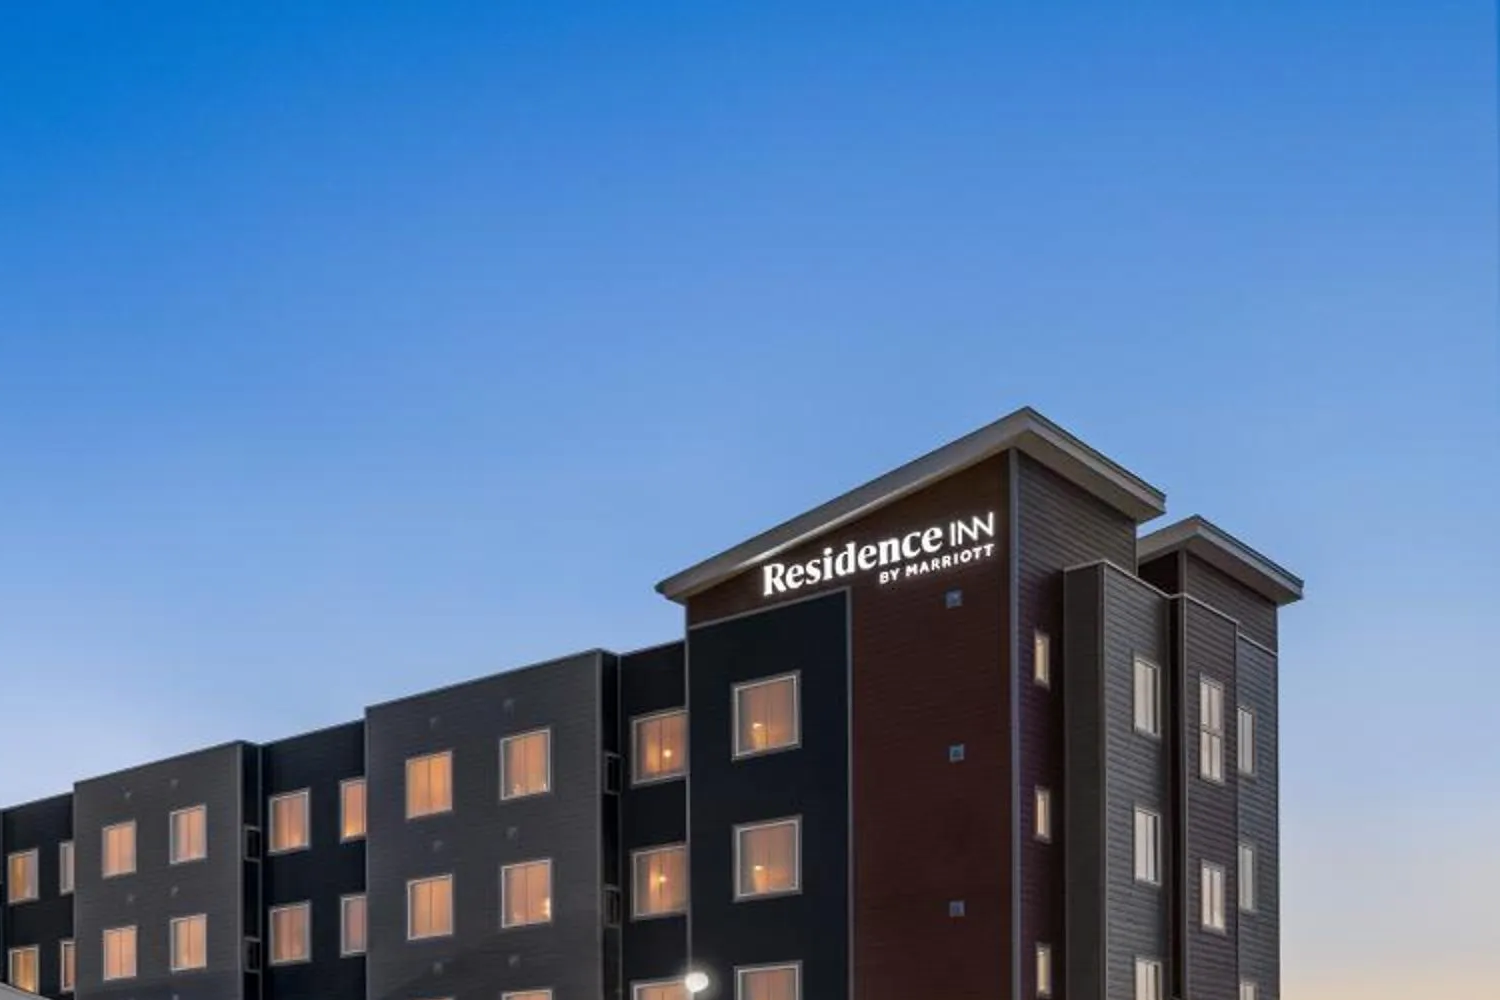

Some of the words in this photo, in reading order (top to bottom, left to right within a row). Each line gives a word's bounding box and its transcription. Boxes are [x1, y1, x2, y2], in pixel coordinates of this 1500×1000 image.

[762, 526, 944, 597] Residence
[949, 511, 996, 547] INN
[879, 569, 900, 585] BY
[905, 543, 996, 578] MARRIOTT
